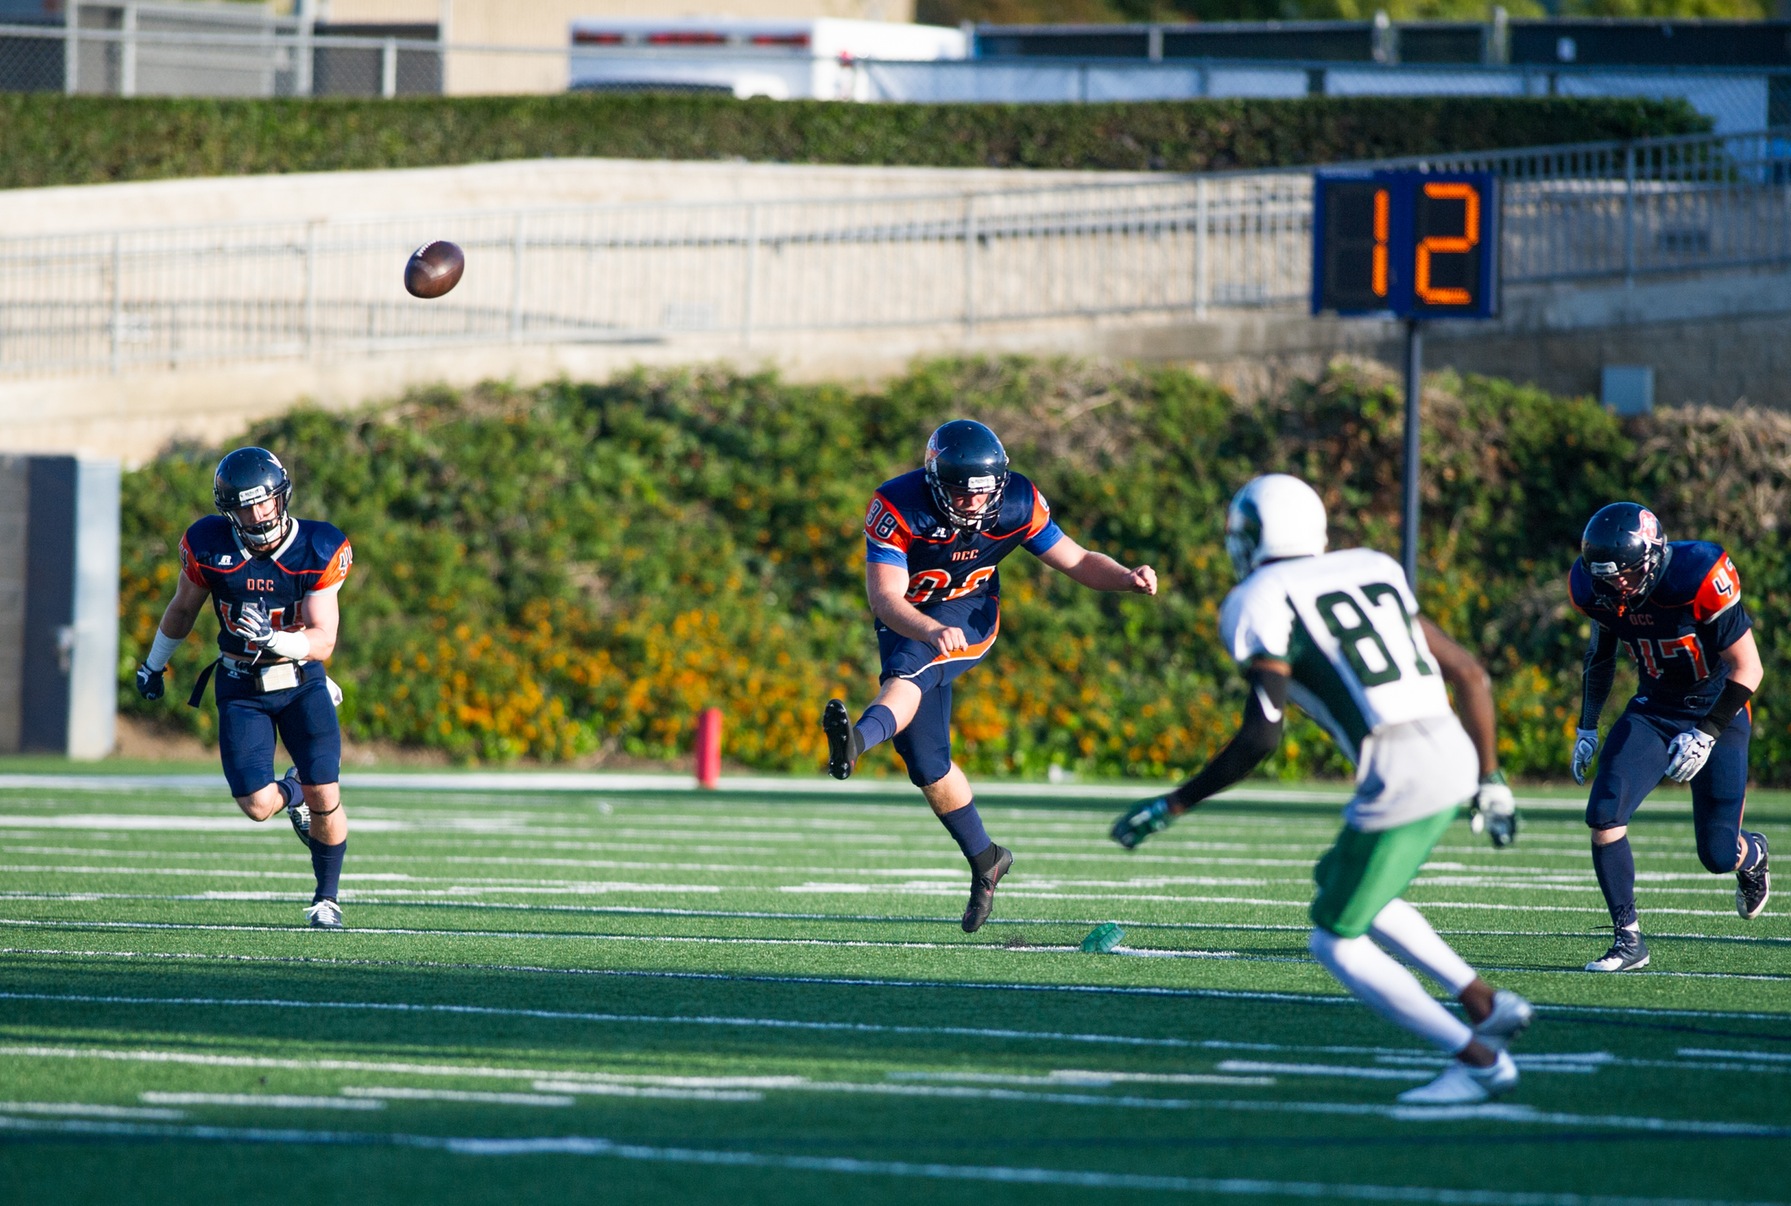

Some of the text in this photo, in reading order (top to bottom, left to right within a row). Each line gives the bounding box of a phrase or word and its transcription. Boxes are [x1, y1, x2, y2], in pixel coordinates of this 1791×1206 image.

[1371, 182, 1481, 305] 12
[866, 498, 898, 539] 98
[951, 549, 980, 563] OCC
[246, 577, 275, 593] OCC
[1628, 613, 1655, 627] OCC
[1316, 582, 1433, 687] 87
